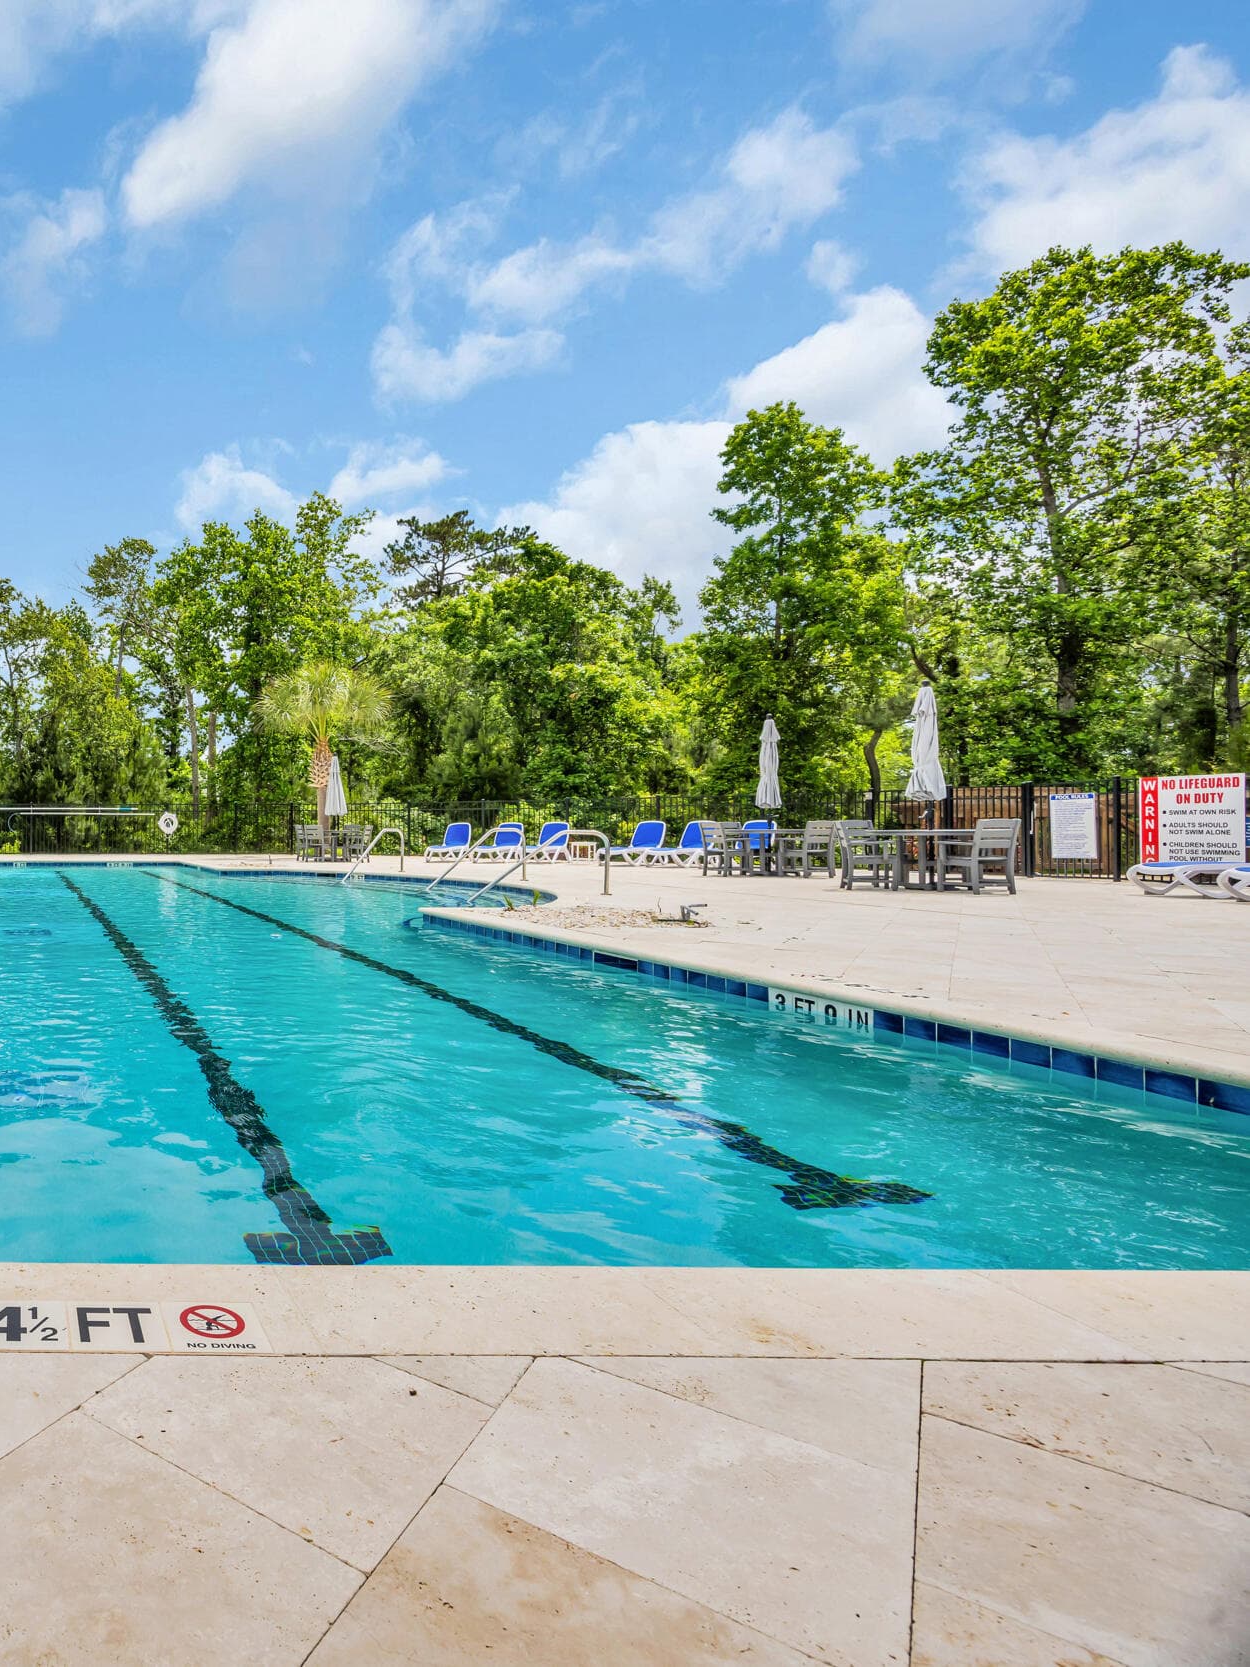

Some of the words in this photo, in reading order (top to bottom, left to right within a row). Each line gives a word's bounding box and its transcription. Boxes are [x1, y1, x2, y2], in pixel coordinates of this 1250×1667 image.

[1161, 779, 1176, 790] NO
[1179, 776, 1240, 789] LIFEGUARD
[1176, 793, 1190, 804] ON
[1194, 792, 1224, 803] DUTY
[795, 997, 815, 1012] FT
[849, 1008, 868, 1025] IN
[76, 1307, 152, 1343] FT
